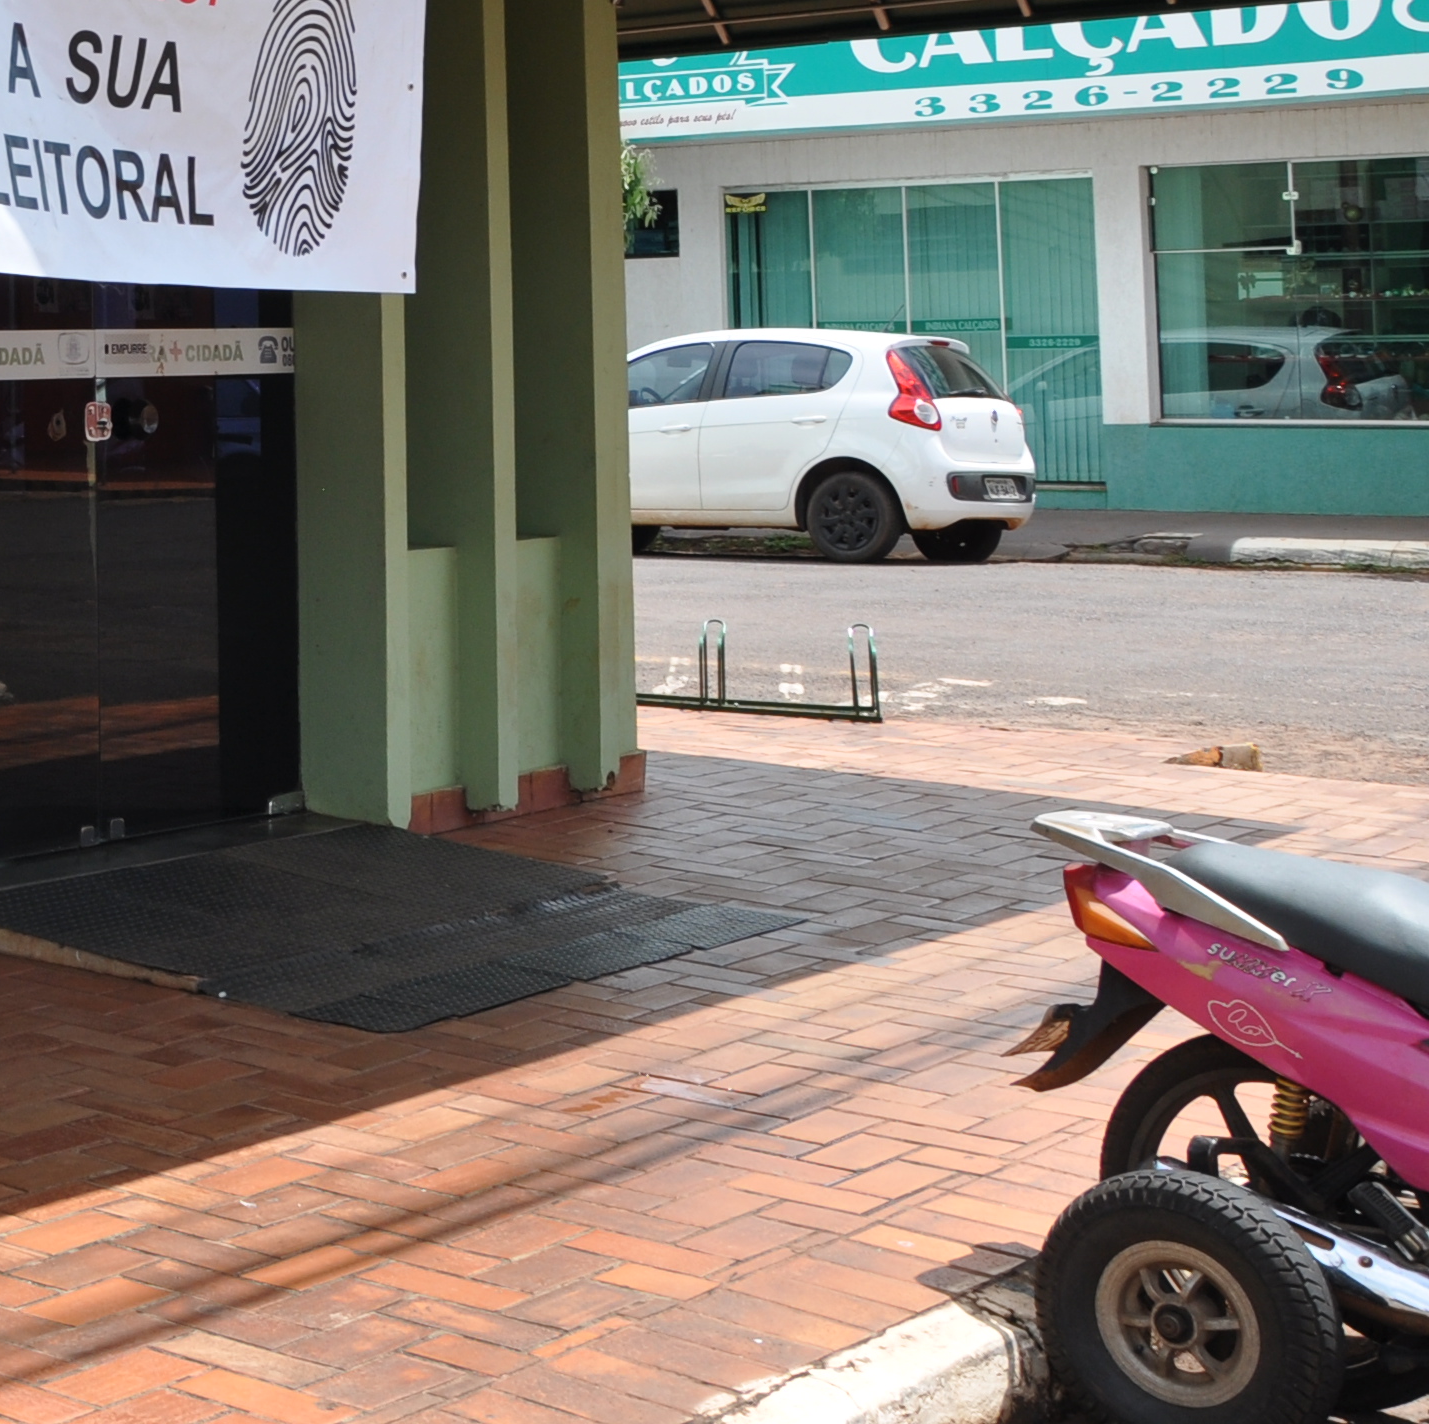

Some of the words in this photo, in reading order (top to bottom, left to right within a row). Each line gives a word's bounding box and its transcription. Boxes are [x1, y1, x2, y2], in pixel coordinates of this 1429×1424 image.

[7, 21, 42, 99] A
[64, 29, 183, 114] SUA
[619, 71, 756, 102] LÇADOS
[913, 67, 1365, 118] 3326-2229
[111, 342, 148, 355] EMPURRE
[185, 340, 244, 363] CIDADÃ
